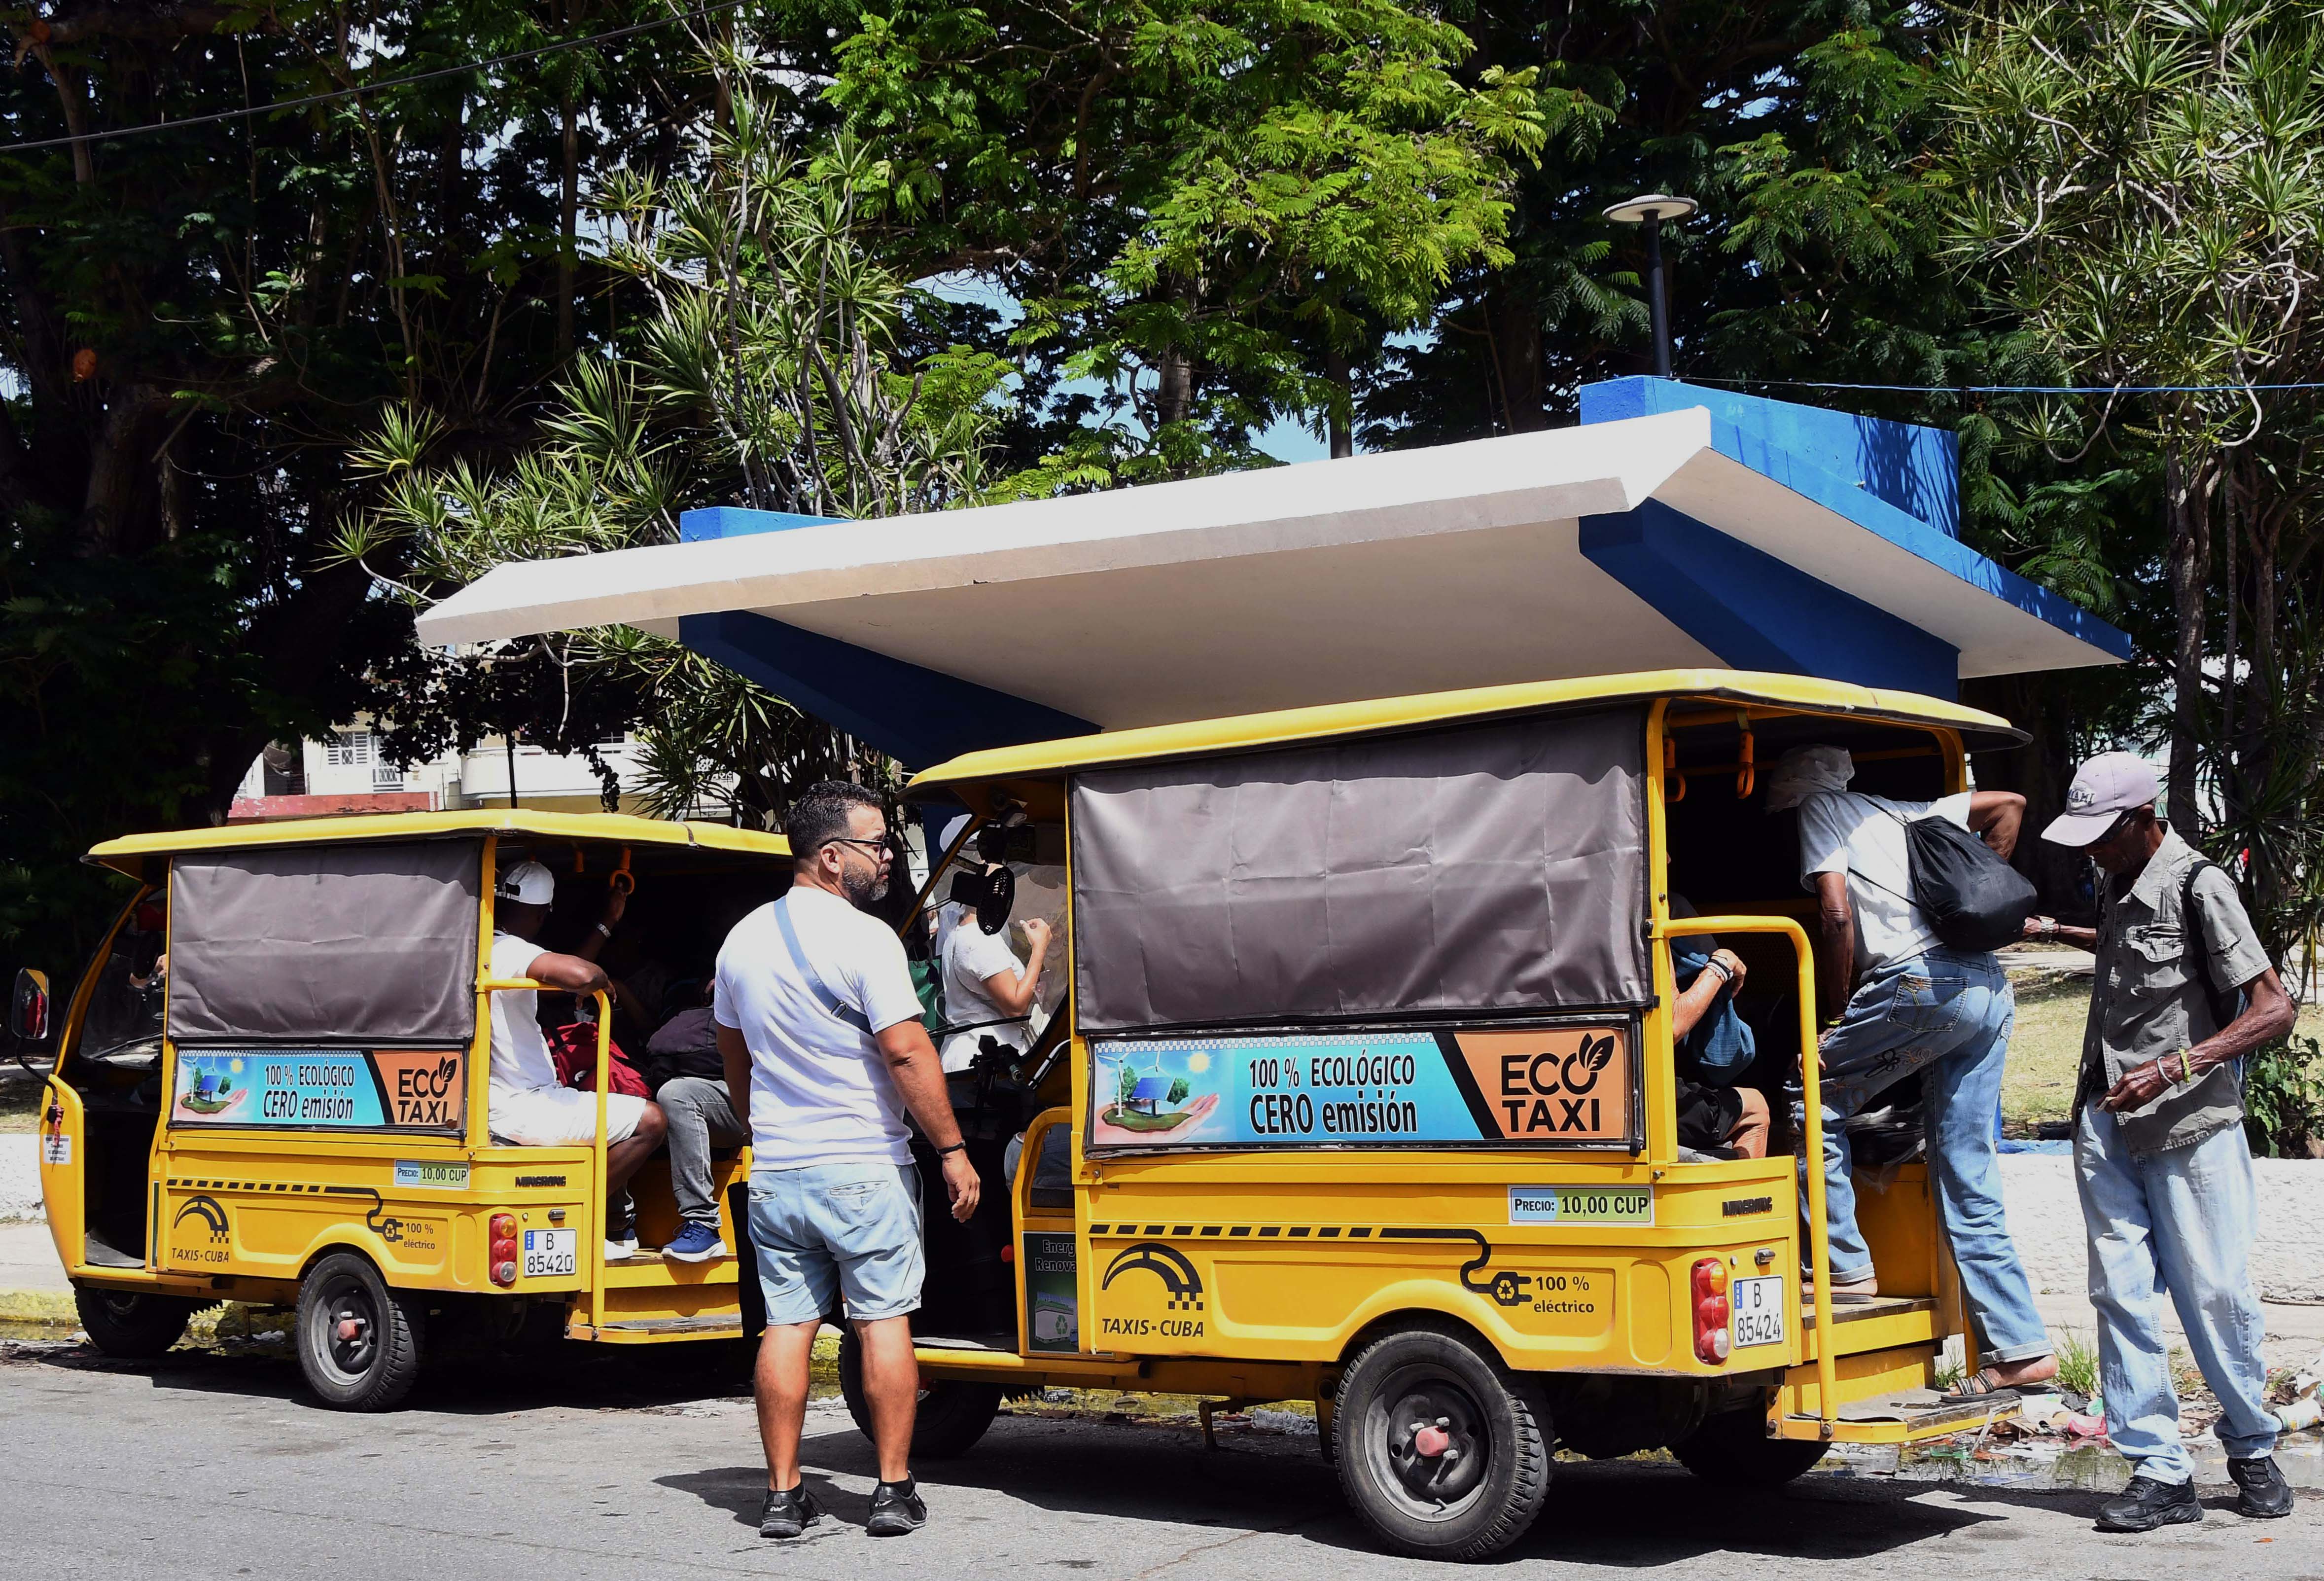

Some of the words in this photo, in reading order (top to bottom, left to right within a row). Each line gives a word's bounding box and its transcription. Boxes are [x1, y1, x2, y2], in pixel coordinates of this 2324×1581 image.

[265, 1065, 281, 1085] 100
[284, 1064, 293, 1086] %
[299, 1061, 354, 1086] ECOLÓGICO
[1250, 1059, 1278, 1088] 100
[1284, 1057, 1300, 1088] %
[1311, 1049, 1414, 1087] ECOLÓGICO
[1501, 1052, 1598, 1096] ECO
[398, 1068, 449, 1098] ECO
[264, 1090, 298, 1117] CERO
[302, 1090, 353, 1119] emisión
[399, 1100, 448, 1124] TAXI
[1250, 1093, 1313, 1134] CERO
[1322, 1090, 1417, 1133] emisión
[1502, 1098, 1600, 1133] TAXI
[422, 1167, 446, 1182] 10,00
[449, 1169, 466, 1182] CUP
[1562, 1196, 1608, 1217] 10,00
[1614, 1196, 1648, 1214] CUP
[406, 1222, 422, 1233] 100
[424, 1223, 433, 1234] %
[404, 1239, 435, 1250] eléctrico
[546, 1233, 554, 1250] B
[528, 1254, 572, 1273] 85420
[1536, 1276, 1566, 1291] 100
[1572, 1276, 1589, 1291] %
[1754, 1283, 1761, 1308] B
[1534, 1299, 1594, 1313] eléctrico
[1737, 1313, 1781, 1342] 85424
